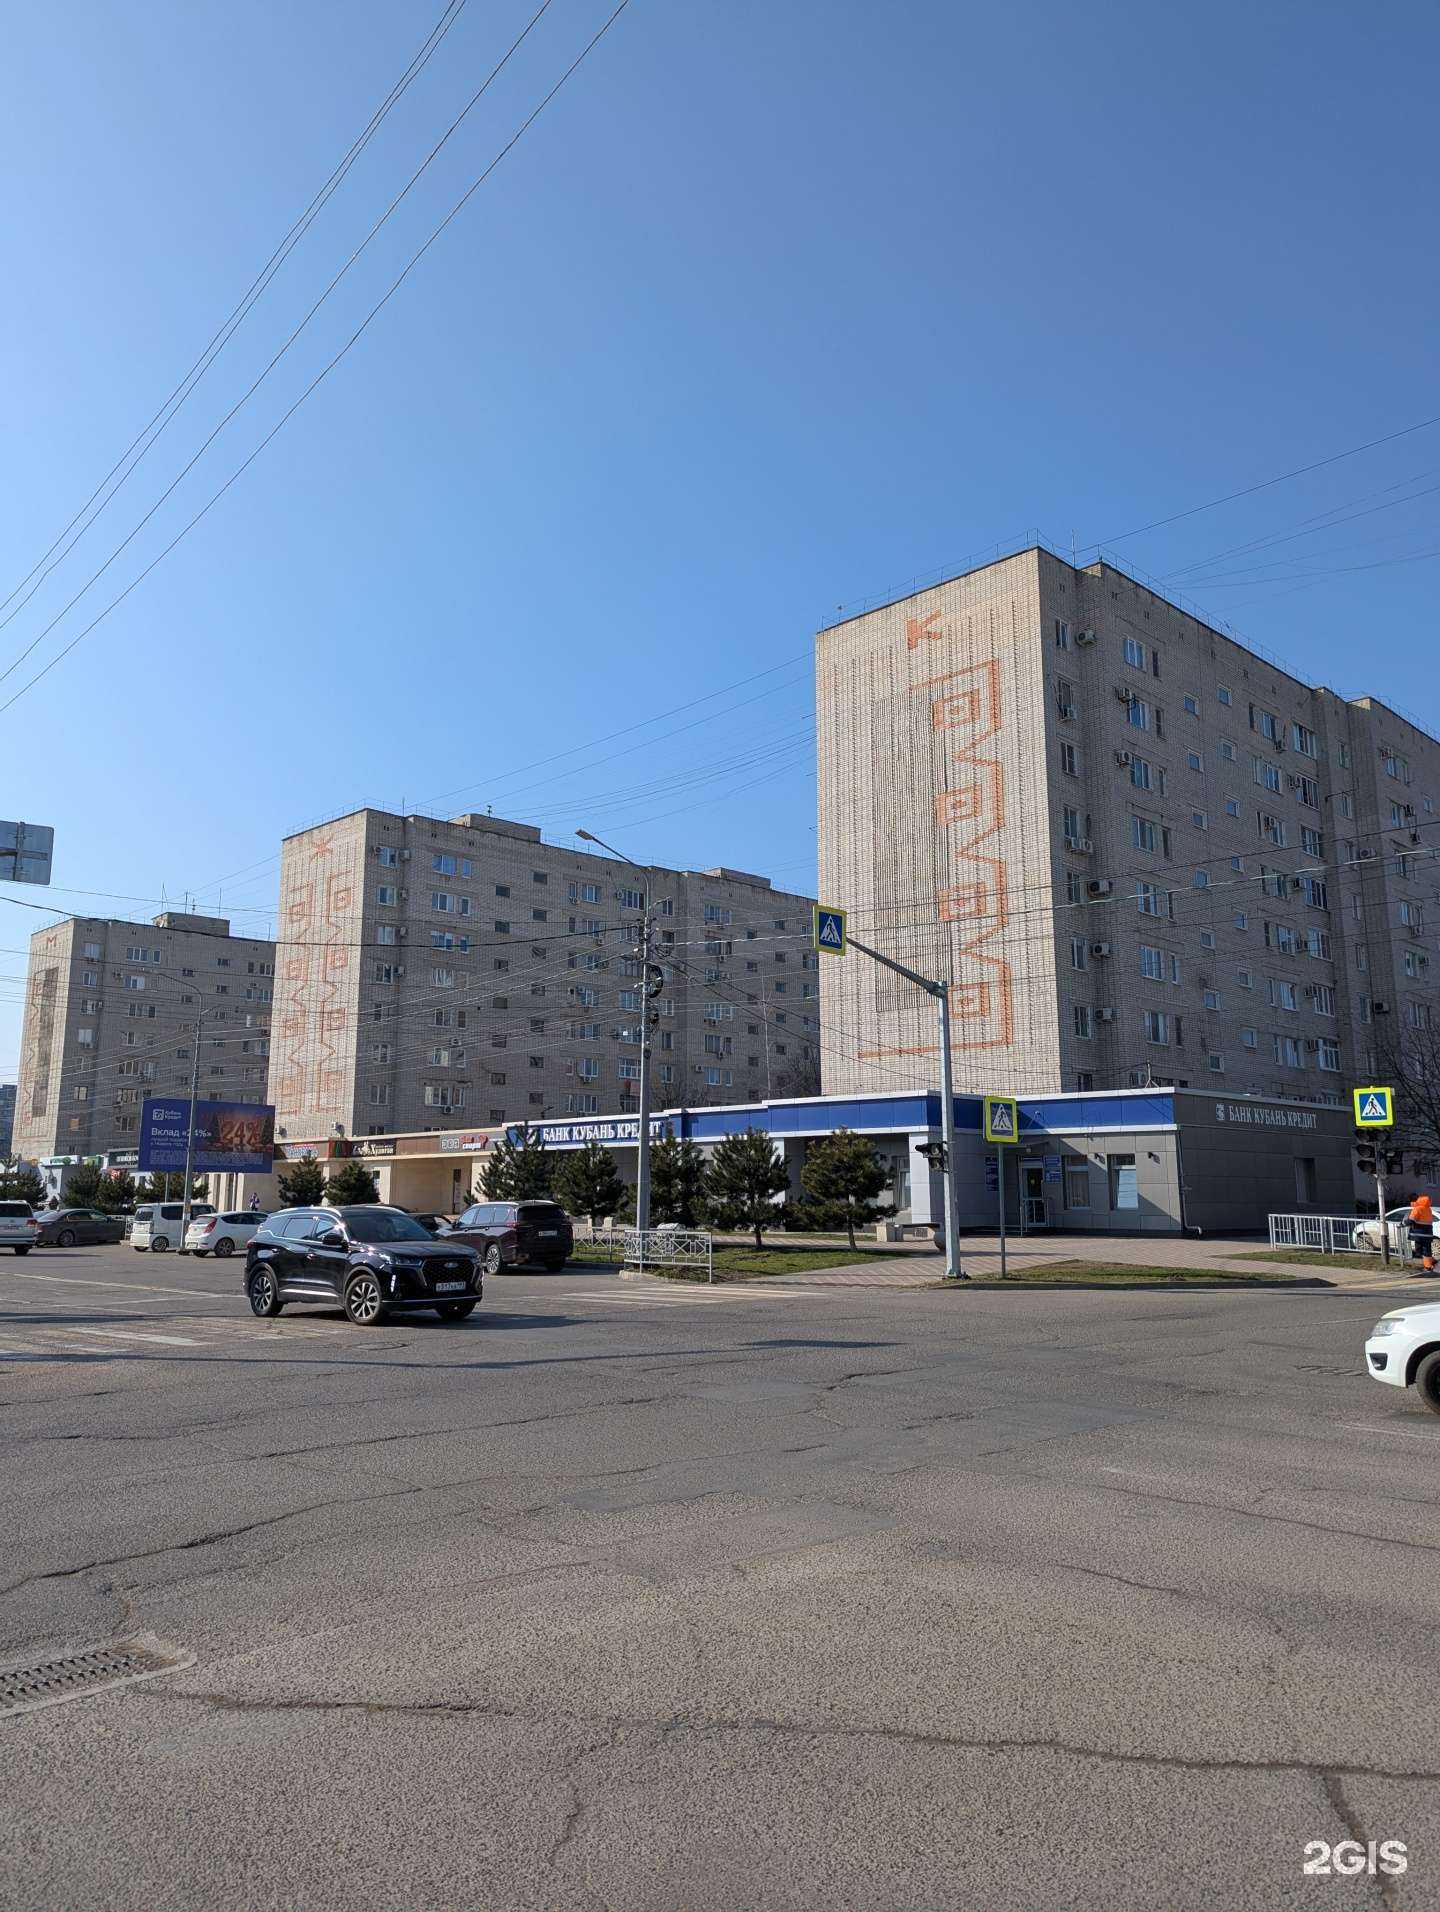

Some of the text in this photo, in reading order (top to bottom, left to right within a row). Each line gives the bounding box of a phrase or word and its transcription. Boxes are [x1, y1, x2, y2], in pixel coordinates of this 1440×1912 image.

[1228, 1105, 1317, 1129] БАНК КУБАНЬ КРЕДИТ
[151, 1127, 180, 1137] Вклад
[543, 1121, 661, 1142] БАНК КУБАНЬ КРЕИТ
